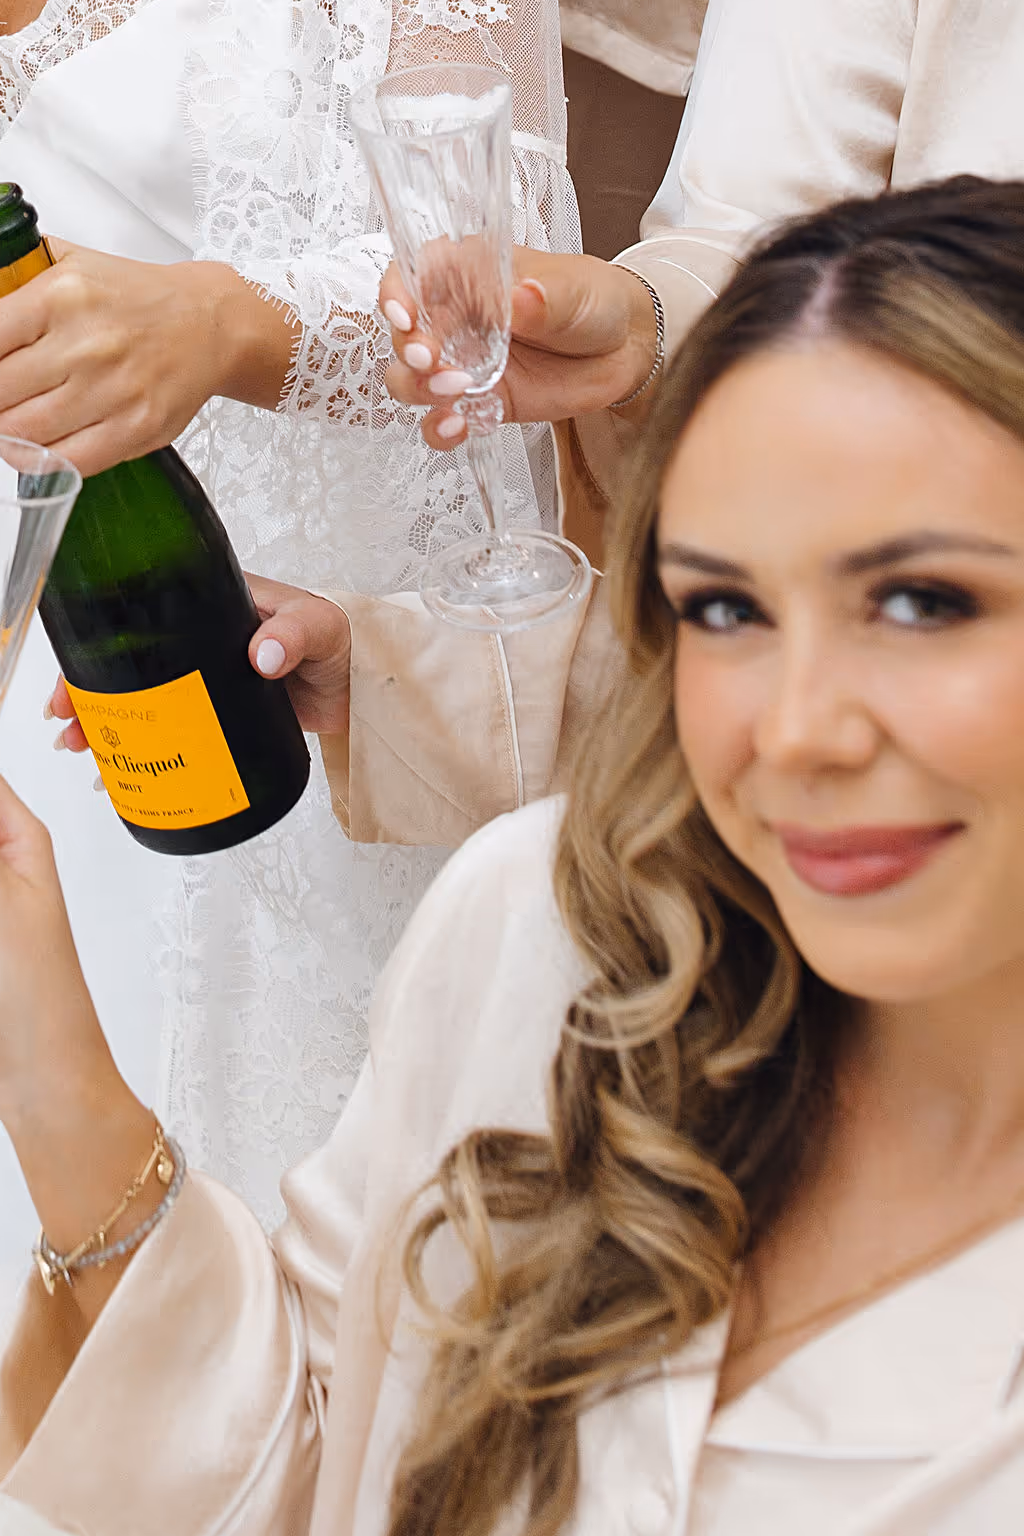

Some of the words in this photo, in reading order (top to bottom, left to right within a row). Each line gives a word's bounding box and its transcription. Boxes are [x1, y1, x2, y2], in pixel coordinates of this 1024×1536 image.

[112, 753, 188, 777] Clicquot
[117, 780, 144, 794] BRUT
[162, 807, 194, 817] FRANCE
